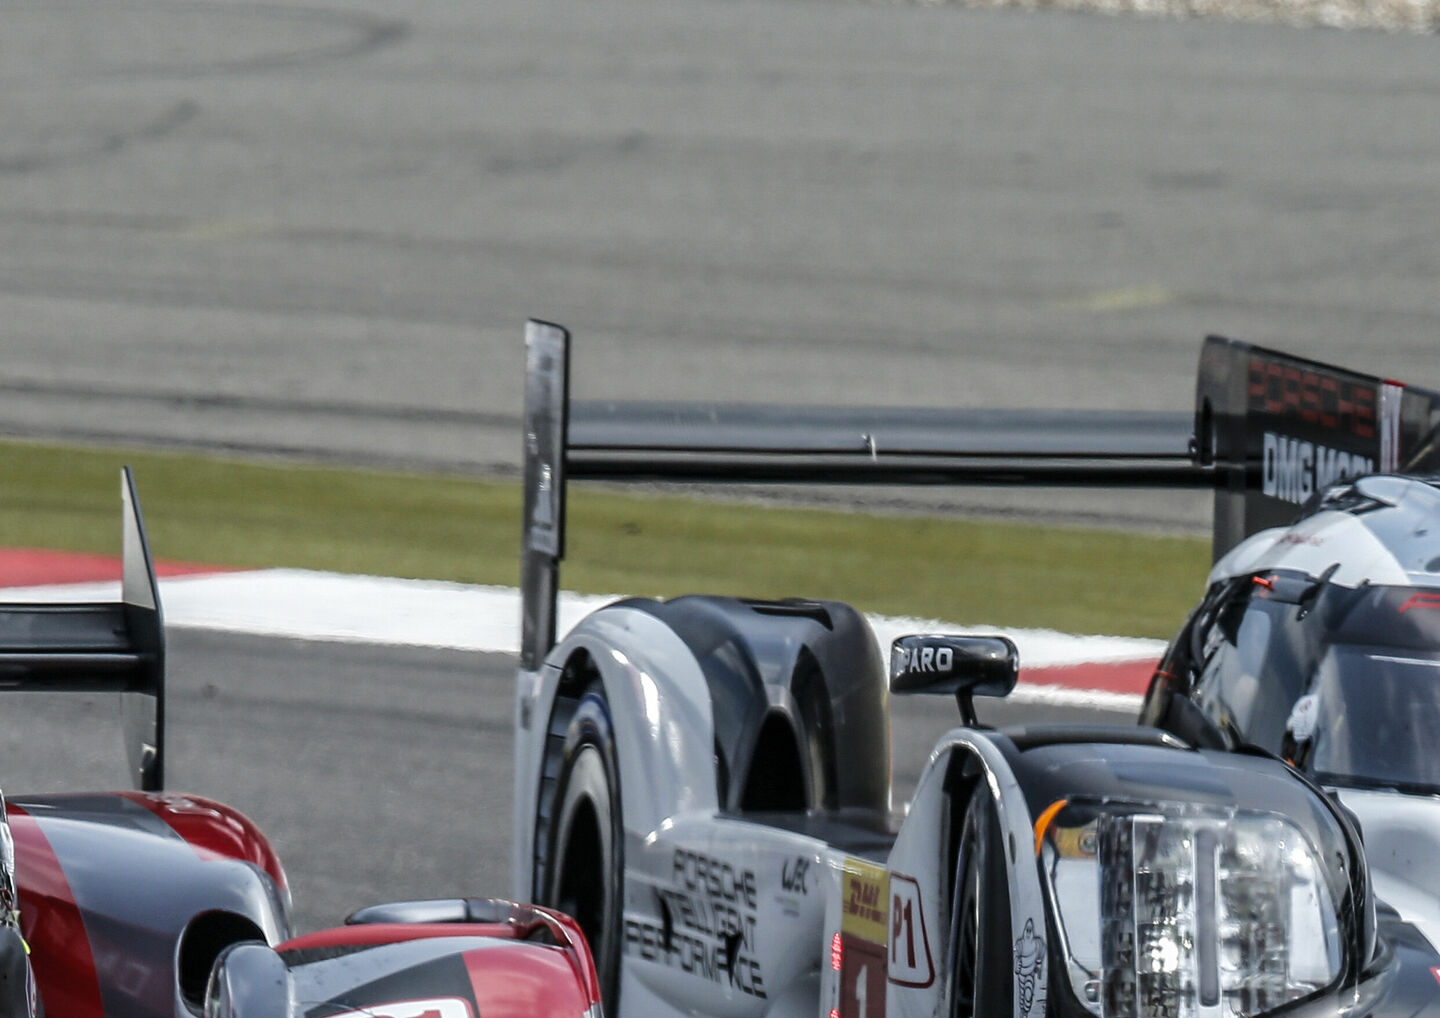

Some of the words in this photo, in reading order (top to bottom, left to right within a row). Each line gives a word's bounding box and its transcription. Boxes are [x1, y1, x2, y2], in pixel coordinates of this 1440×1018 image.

[1248, 360, 1374, 438] PORSCHE
[1263, 431, 1316, 505] DMG
[672, 848, 757, 910] PORSCHE
[849, 878, 881, 922] DHL
[891, 893, 917, 969] P1
